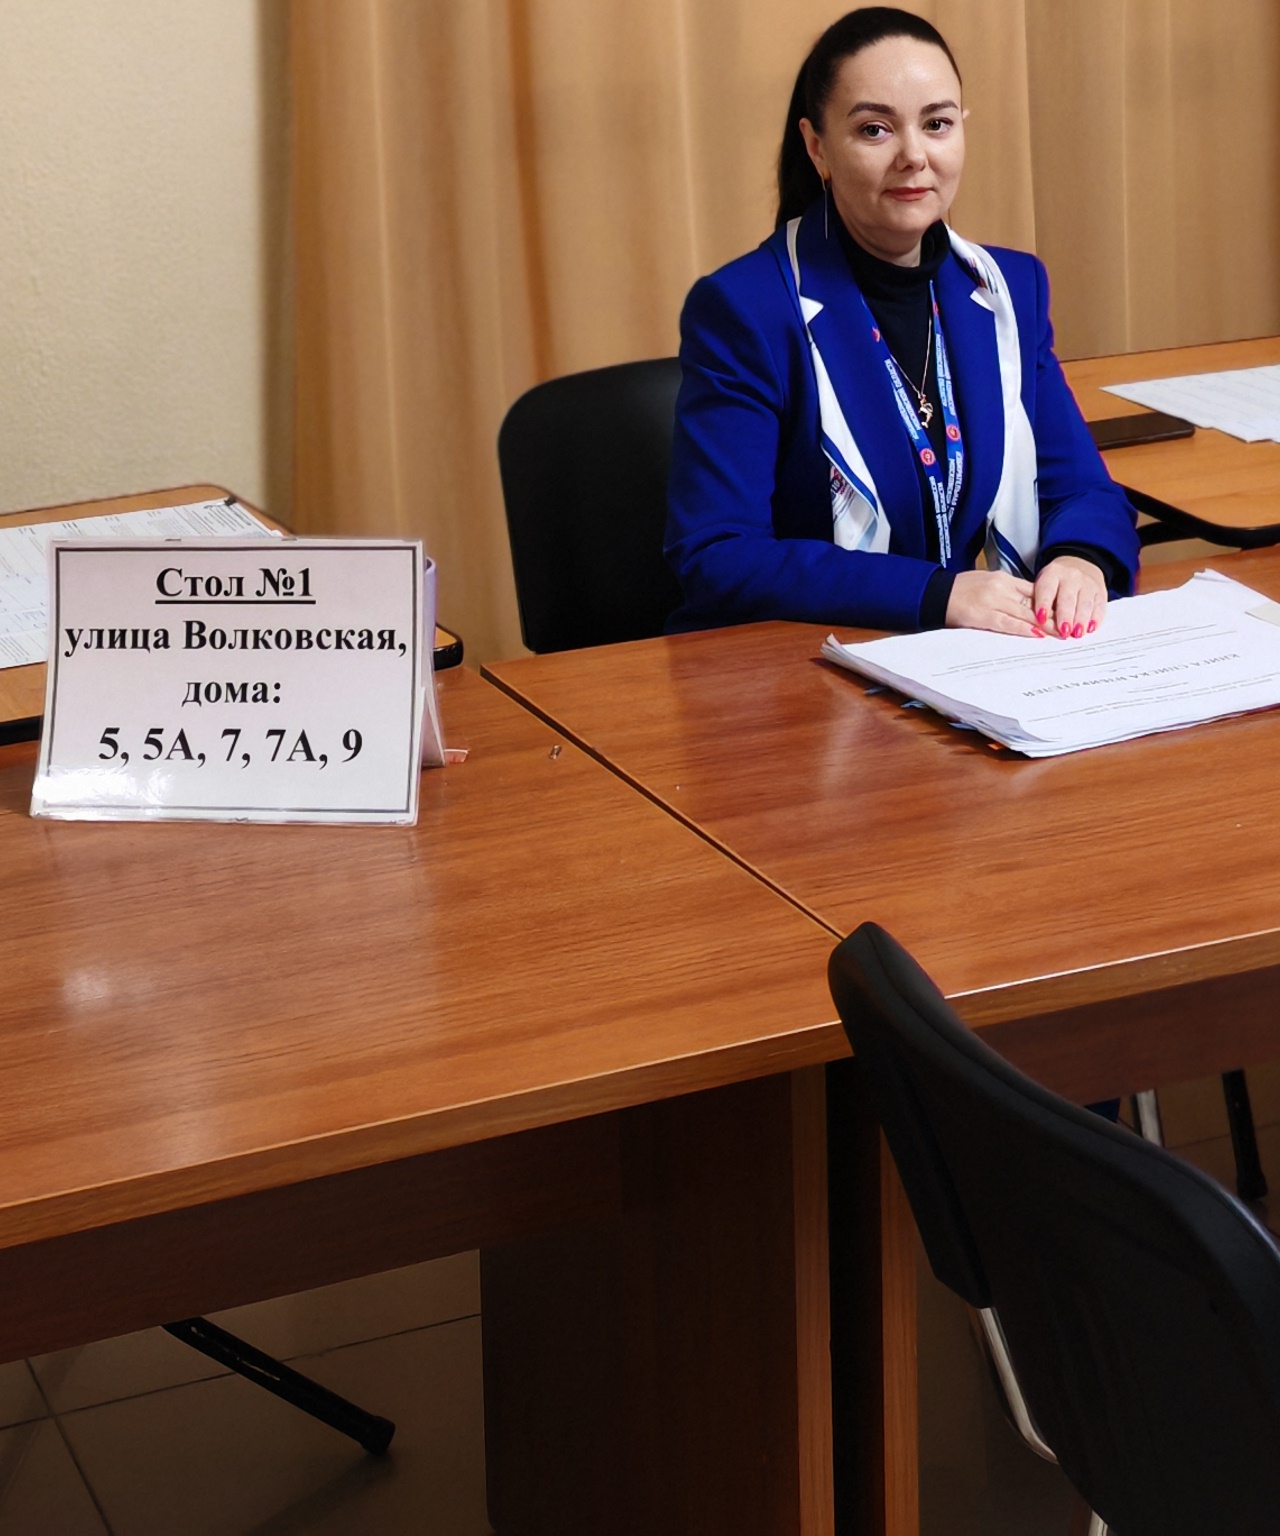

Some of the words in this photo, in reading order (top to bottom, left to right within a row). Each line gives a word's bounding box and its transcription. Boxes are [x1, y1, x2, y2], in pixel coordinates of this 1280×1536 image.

[155, 567, 244, 598] Стол
[256, 567, 313, 598] №1
[64, 626, 170, 657] улица
[183, 620, 407, 657] Волковская,
[181, 681, 281, 707] дома:
[98, 727, 130, 768] 5,
[143, 727, 206, 768] 5А,
[220, 729, 251, 769] 7,
[265, 729, 328, 770] 7А,
[341, 729, 363, 763] 9
